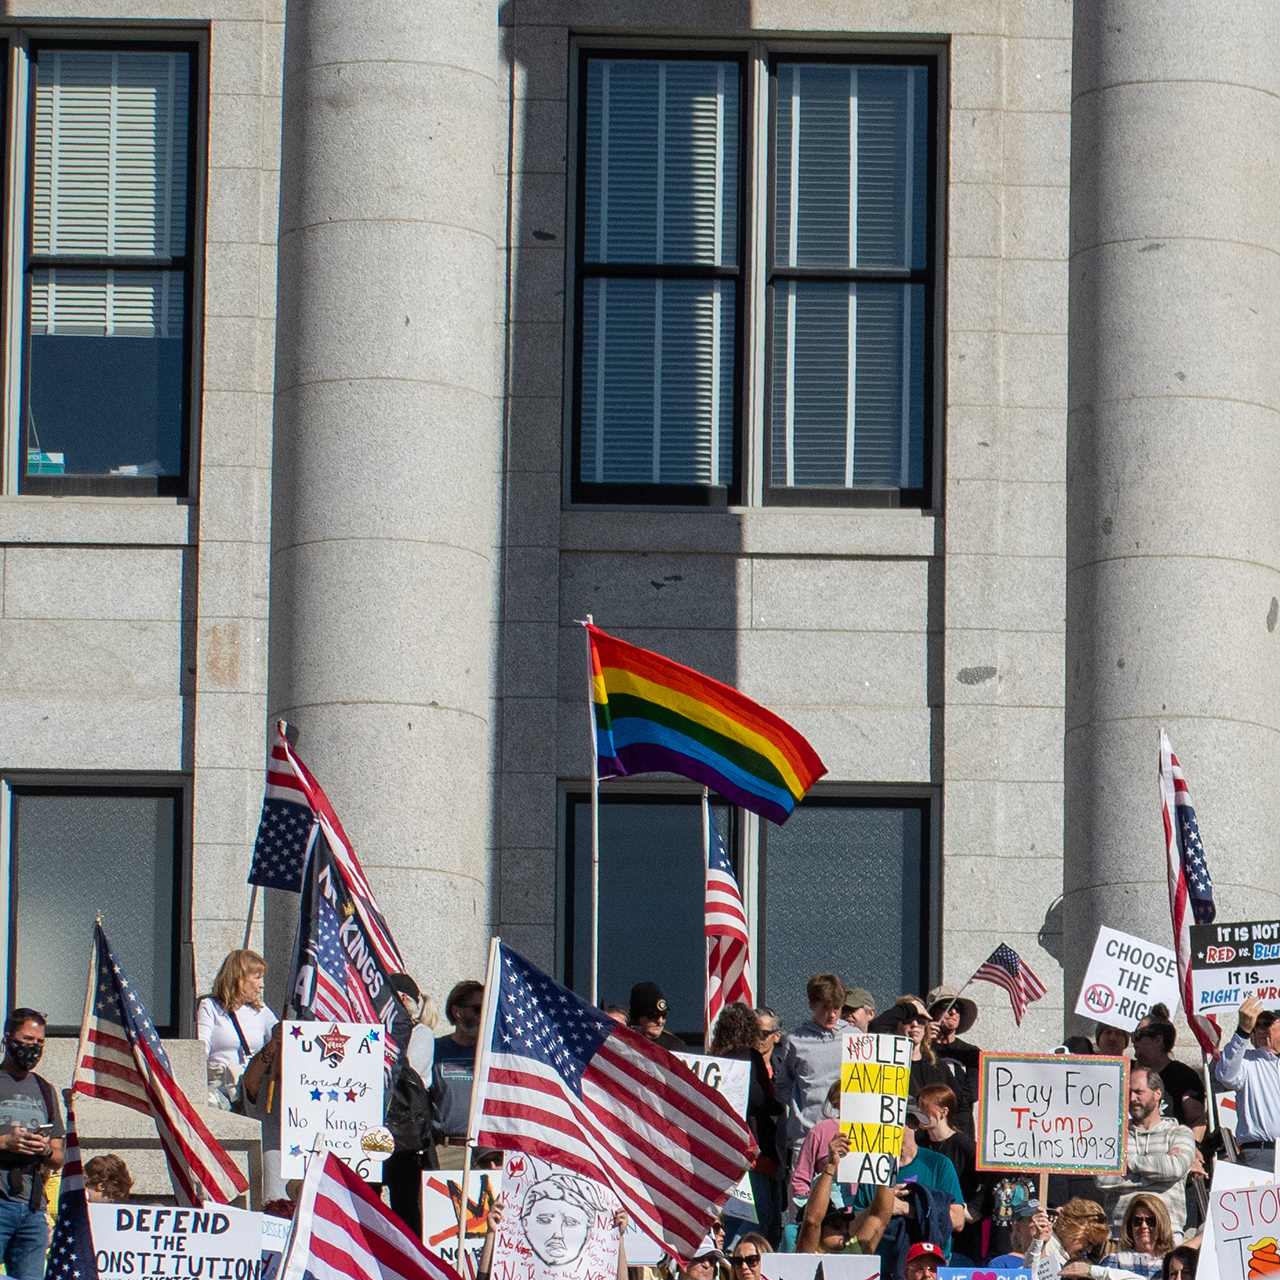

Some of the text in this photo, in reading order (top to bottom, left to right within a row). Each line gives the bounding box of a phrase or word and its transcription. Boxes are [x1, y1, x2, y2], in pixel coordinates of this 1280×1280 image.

[1252, 923, 1280, 939] NOT
[1106, 939, 1177, 978] CHOOSE
[1207, 948, 1235, 963] RED
[1118, 967, 1152, 995] THE
[1201, 988, 1240, 1004] RIGHT
[301, 1074, 373, 1097] Proudly
[997, 1067, 1112, 1117] Pray For
[326, 1109, 367, 1138] Kings
[1011, 1108, 1093, 1145] Trump
[994, 1129, 1116, 1160] Psalms 109:8
[117, 1209, 230, 1234] DEFEND
[151, 1236, 187, 1251] THE
